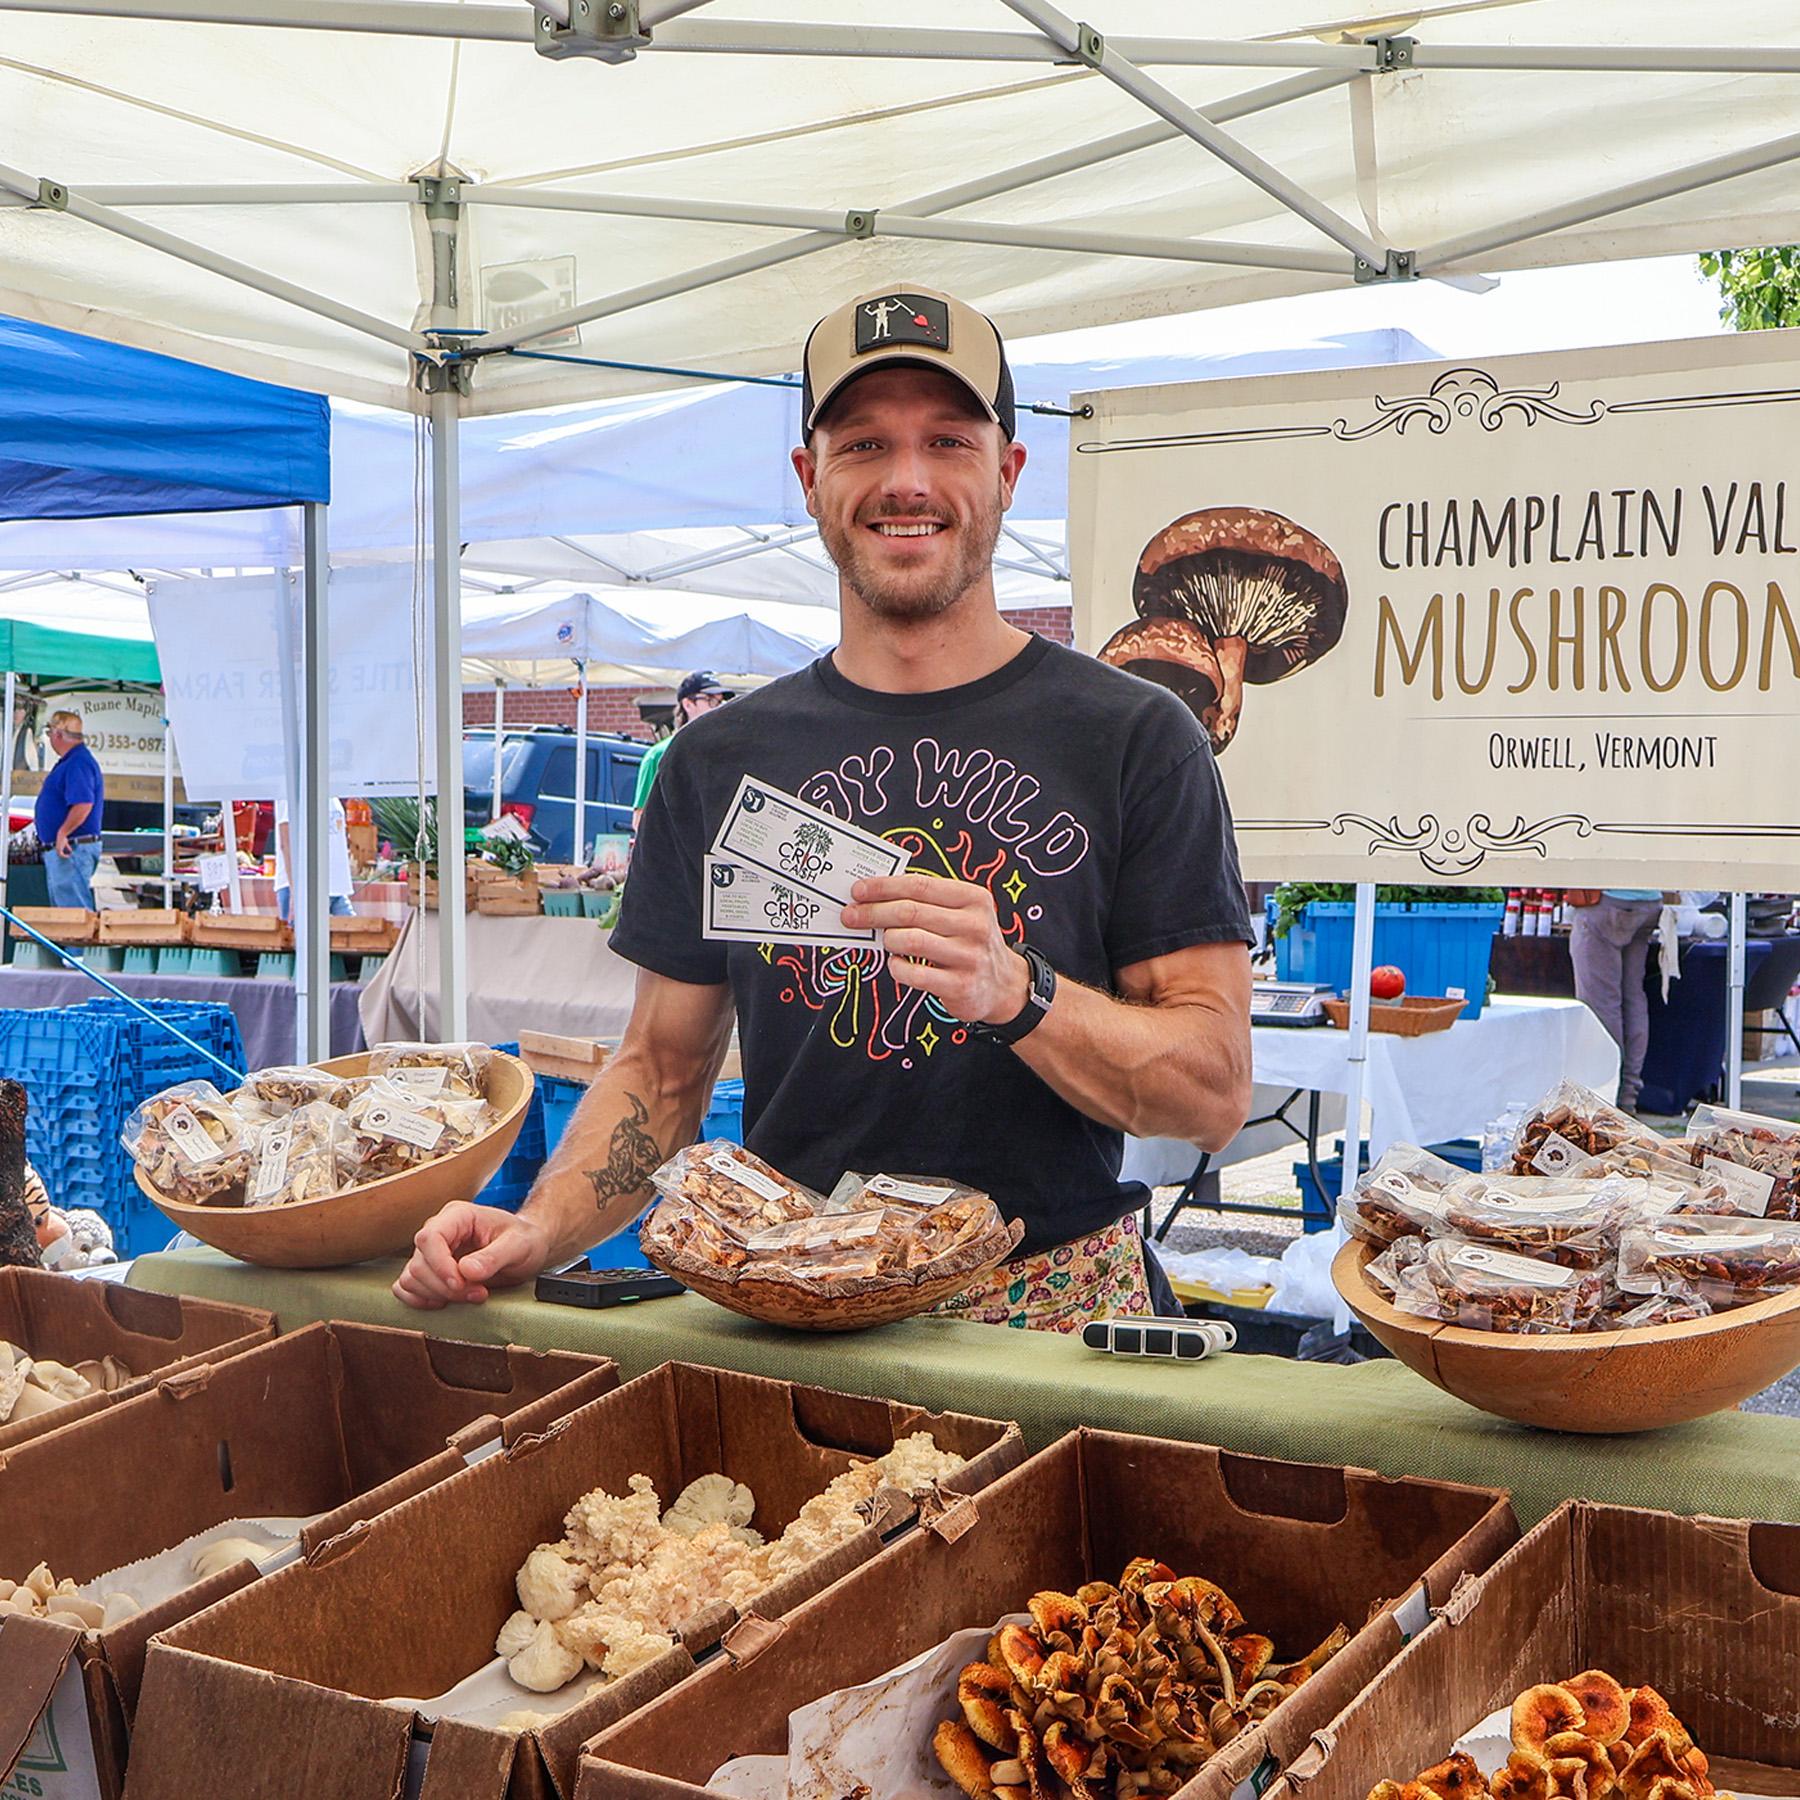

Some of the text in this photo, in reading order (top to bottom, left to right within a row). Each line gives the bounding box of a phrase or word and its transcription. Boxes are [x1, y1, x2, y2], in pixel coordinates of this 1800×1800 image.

[1379, 481, 1798, 570] CHAMPLAIN VAL
[83, 700, 122, 715] Ruane
[744, 790, 761, 811] $1
[797, 738, 1089, 876] AY WILD
[778, 842, 833, 875] CROP
[712, 867, 730, 885] $1
[763, 900, 820, 919] CROP
[4, 1772, 43, 1797] ES
